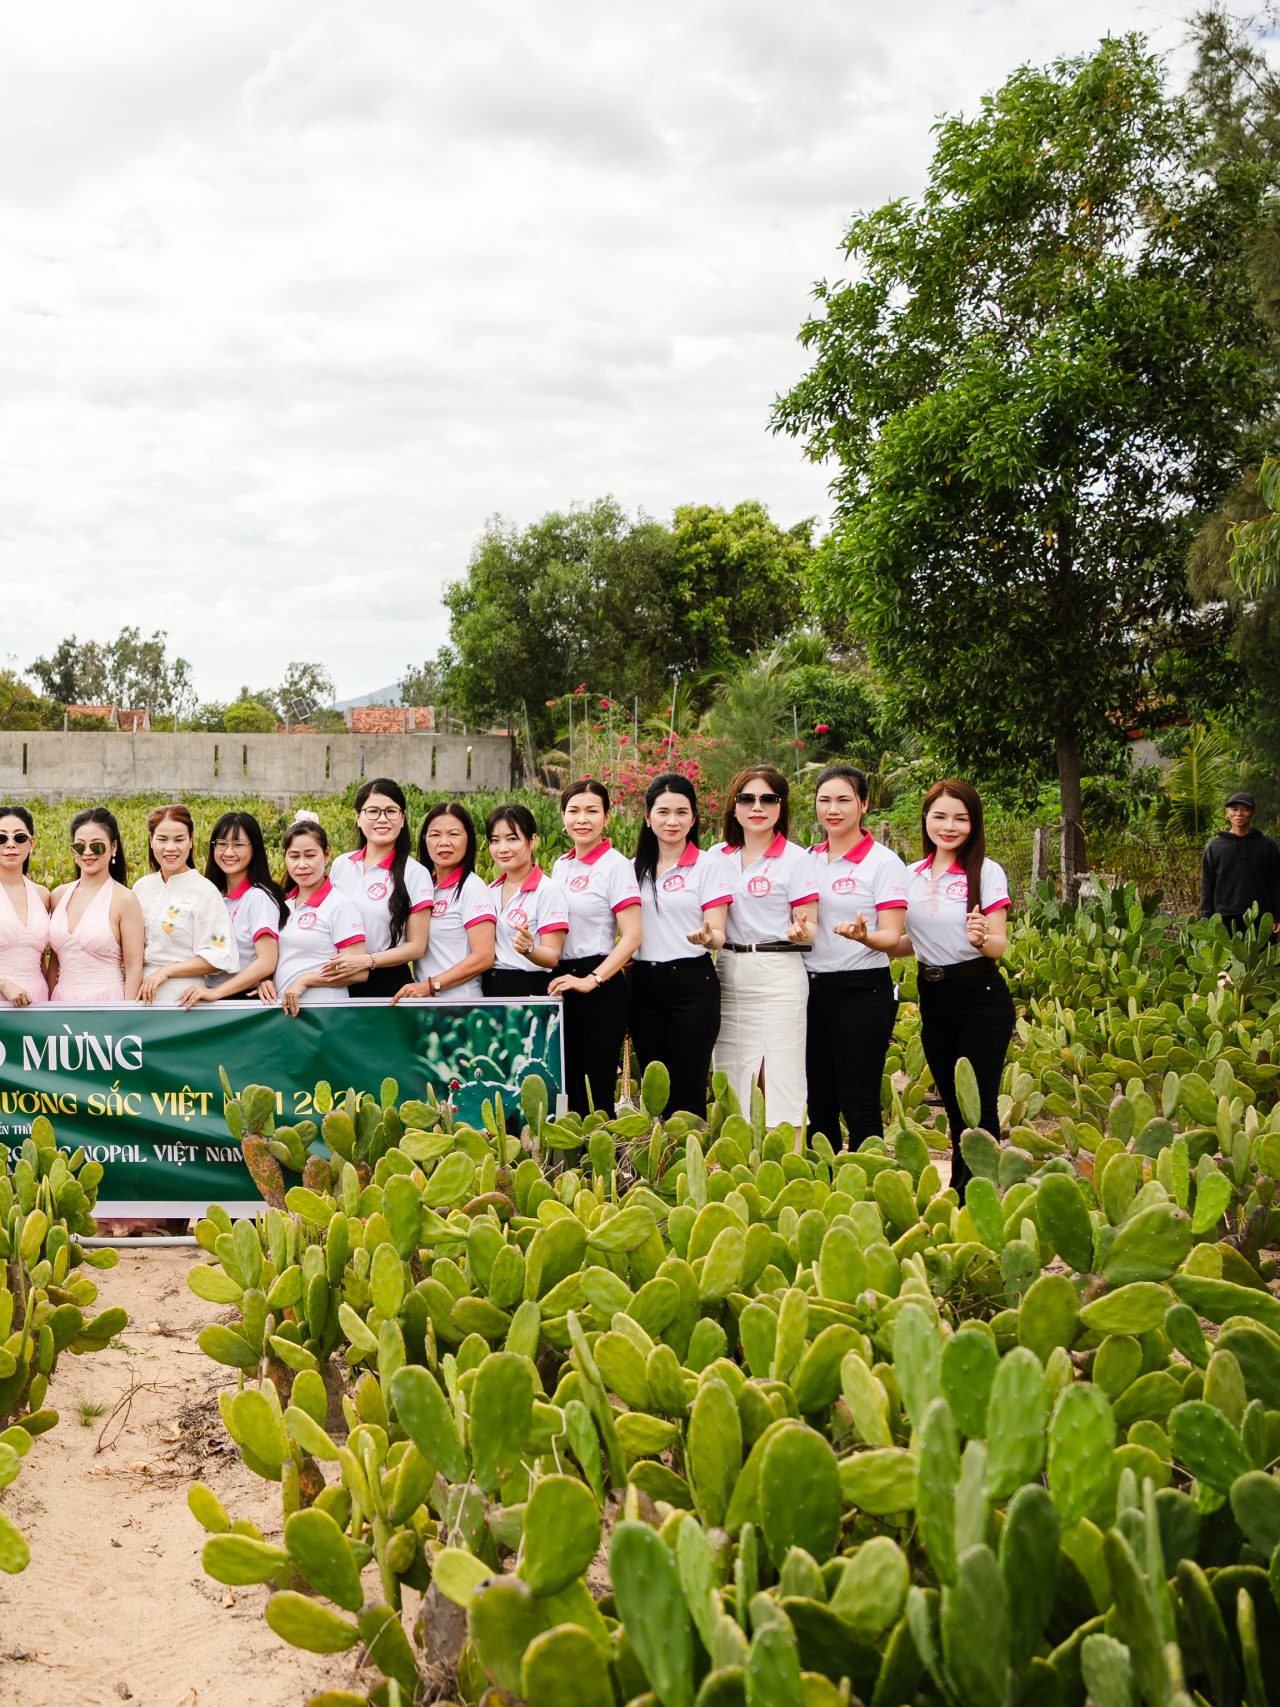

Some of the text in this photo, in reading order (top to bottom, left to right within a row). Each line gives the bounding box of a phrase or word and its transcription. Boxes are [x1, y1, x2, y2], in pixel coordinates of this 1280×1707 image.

[750, 881, 769, 892] 199
[834, 880, 853, 890] 123
[23, 1024, 143, 1071] MỪNG
[87, 1080, 142, 1116] SẮC
[151, 1085, 214, 1122] VIỆT
[12, 1122, 33, 1135] THĂ
[153, 1141, 199, 1167] VIỆT
